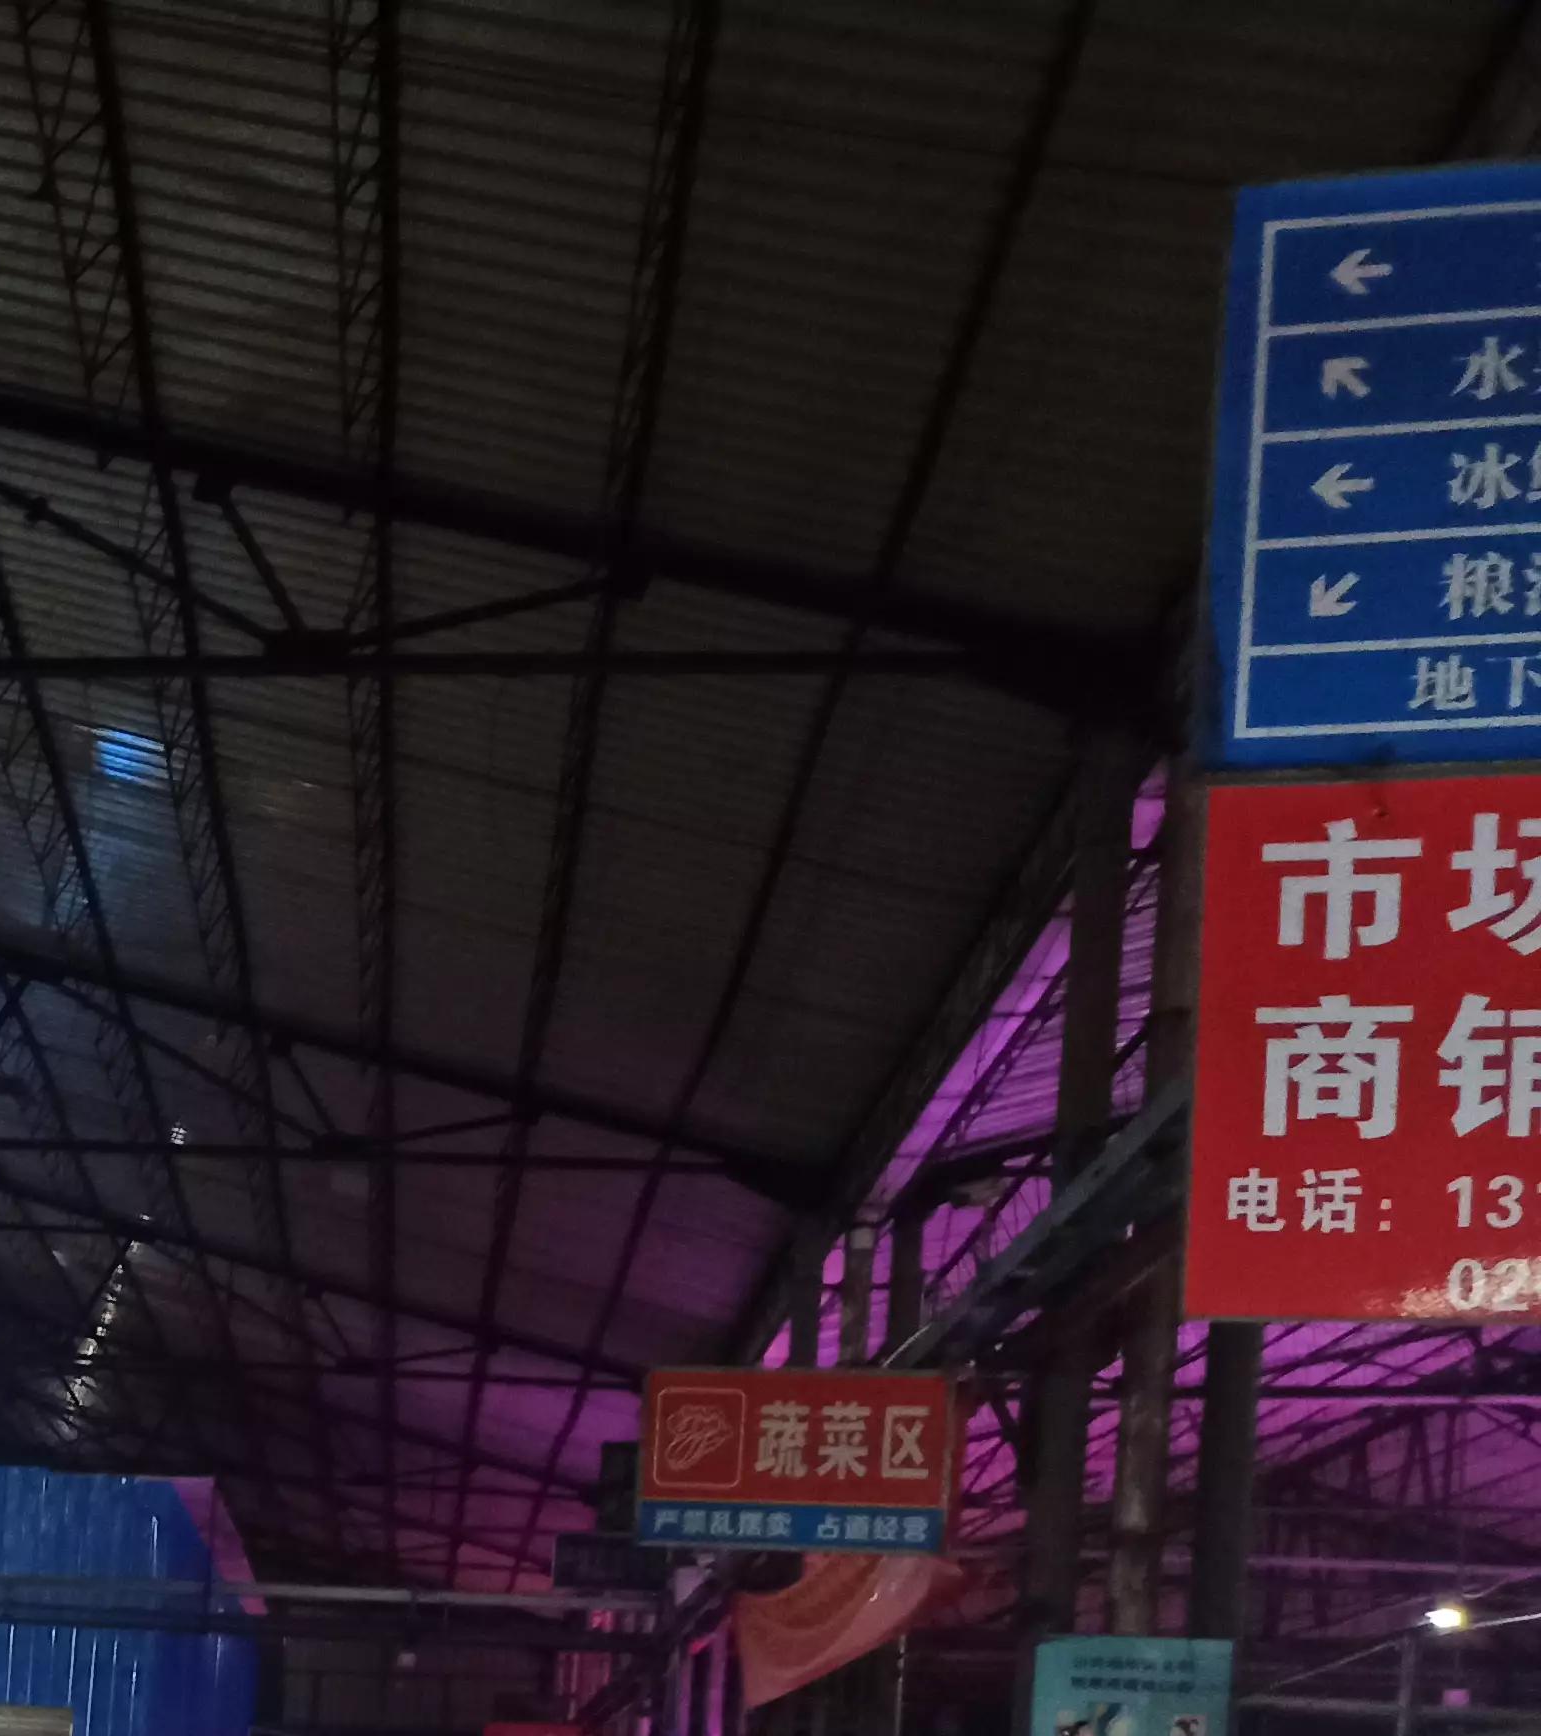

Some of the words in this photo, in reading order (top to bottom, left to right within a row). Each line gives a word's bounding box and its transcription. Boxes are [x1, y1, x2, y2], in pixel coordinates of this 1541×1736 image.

[1449, 335, 1541, 401] 水
[1447, 441, 1541, 510] 冰
[1438, 550, 1541, 621] 粮
[1261, 811, 1541, 961] 市场
[1254, 993, 1541, 1140] 商铺
[1446, 1174, 1541, 1229] 13
[1447, 1257, 1541, 1311] 02
[754, 1400, 931, 1480] 蔬菜区
[816, 1513, 930, 1543] 占道经营
